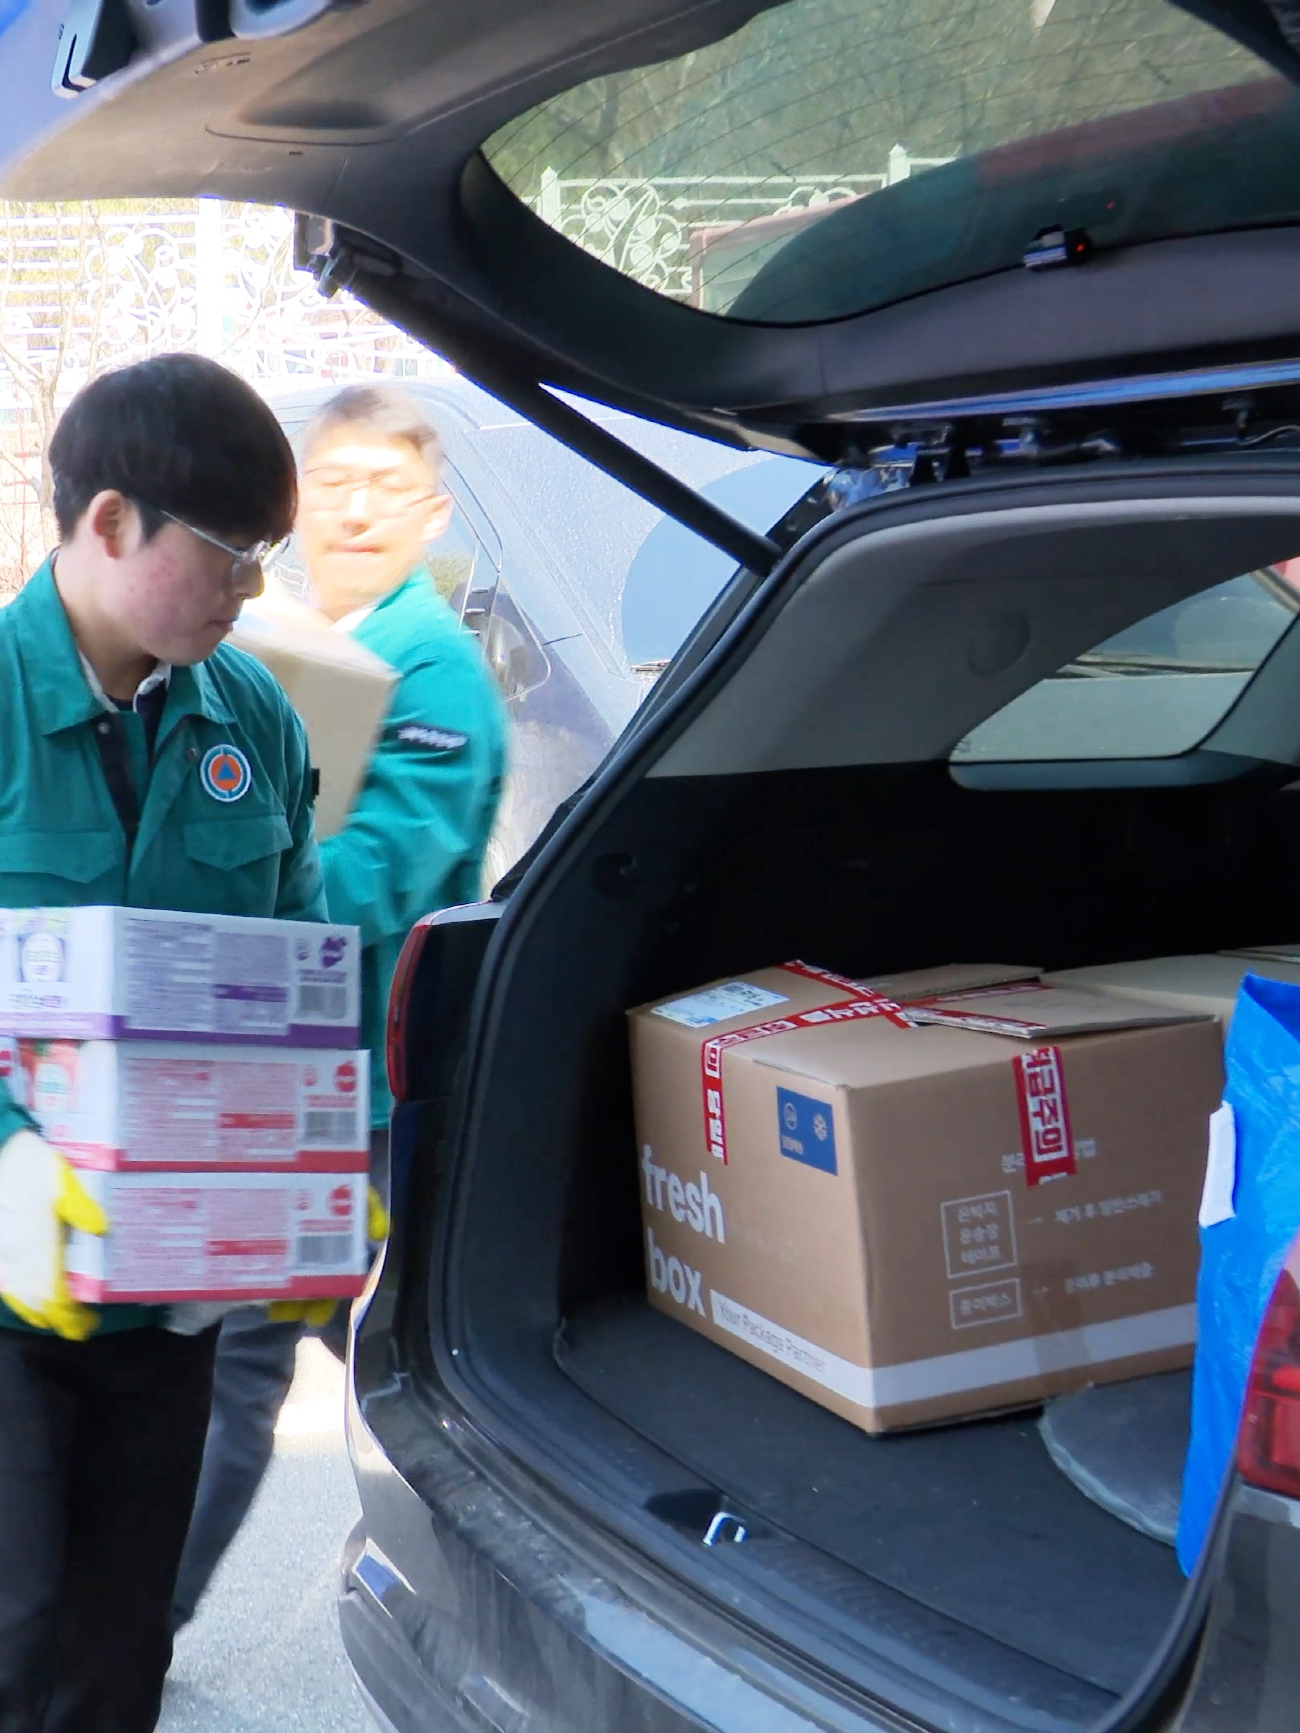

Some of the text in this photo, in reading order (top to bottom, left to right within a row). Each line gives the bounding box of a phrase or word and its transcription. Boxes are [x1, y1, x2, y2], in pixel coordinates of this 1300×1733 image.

[642, 1144, 725, 1244] fresh
[647, 1227, 706, 1318] box
[719, 1299, 827, 1374] Your Package Partner
